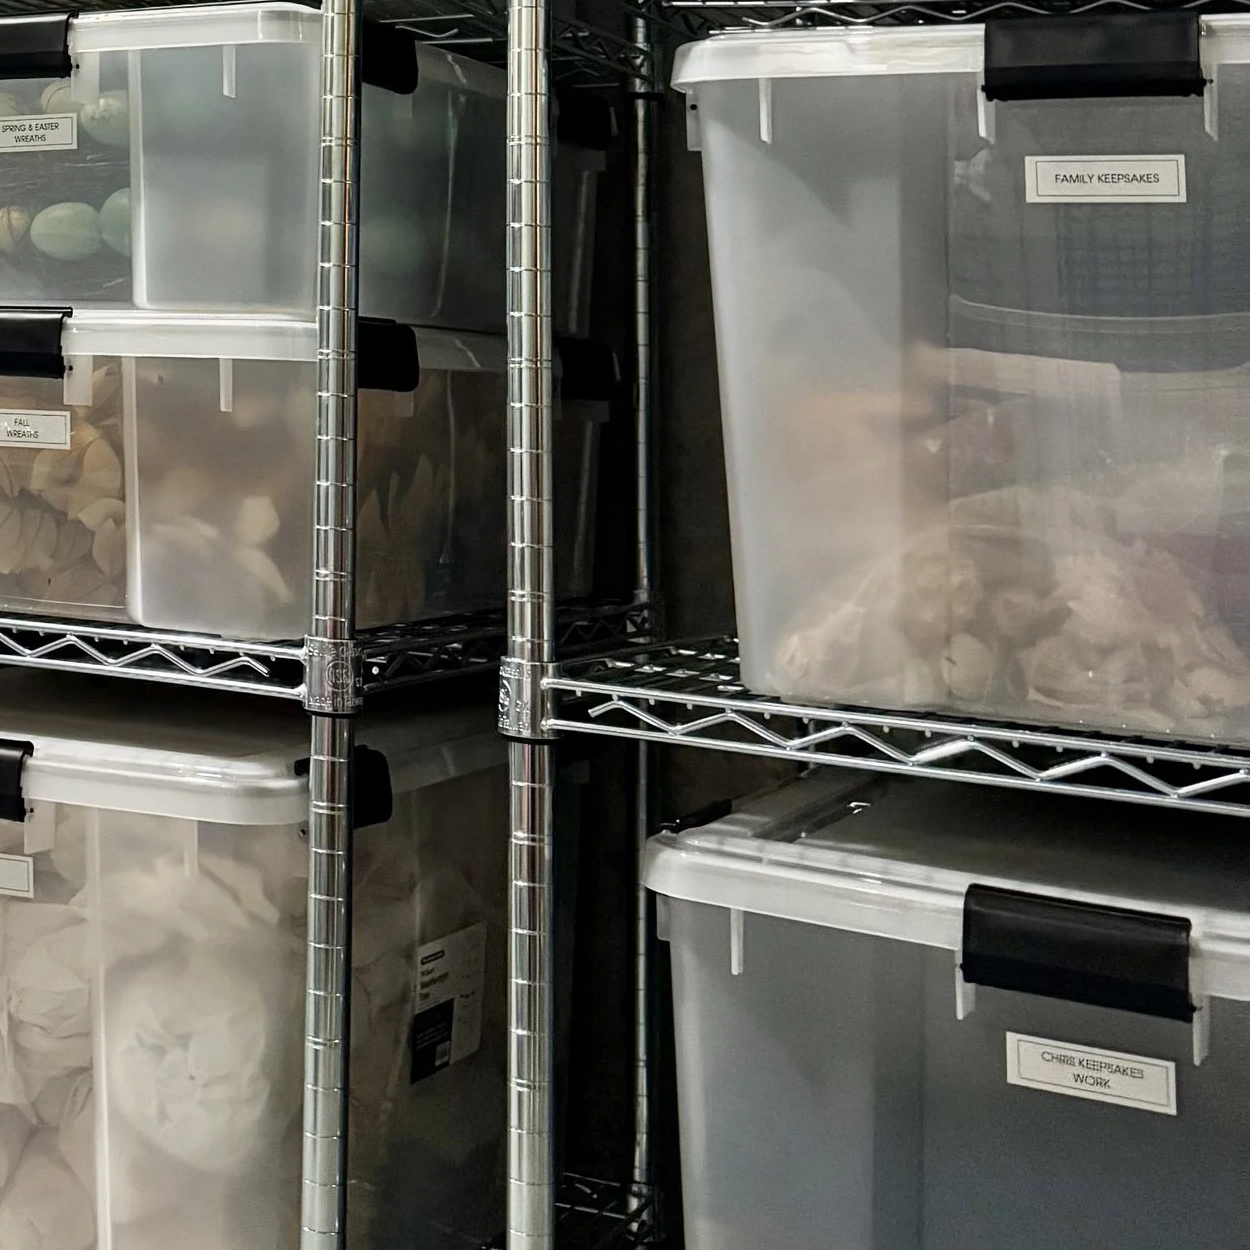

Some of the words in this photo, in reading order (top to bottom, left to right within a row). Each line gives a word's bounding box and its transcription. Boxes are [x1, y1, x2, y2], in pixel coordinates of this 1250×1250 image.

[1, 123, 26, 133] SPRING
[28, 123, 34, 132] &
[35, 122, 60, 132] EASTER
[14, 134, 47, 143] WREATHS
[1054, 172, 1096, 185] FAMILY
[1097, 172, 1160, 185] KEEPSAKES
[14, 417, 30, 427] FALL
[6, 429, 40, 439] WREATHS
[1041, 1051, 1076, 1066] CHRIS
[1078, 1056, 1145, 1081] KEEPSAKES
[1072, 1072, 1111, 1089] WORK
